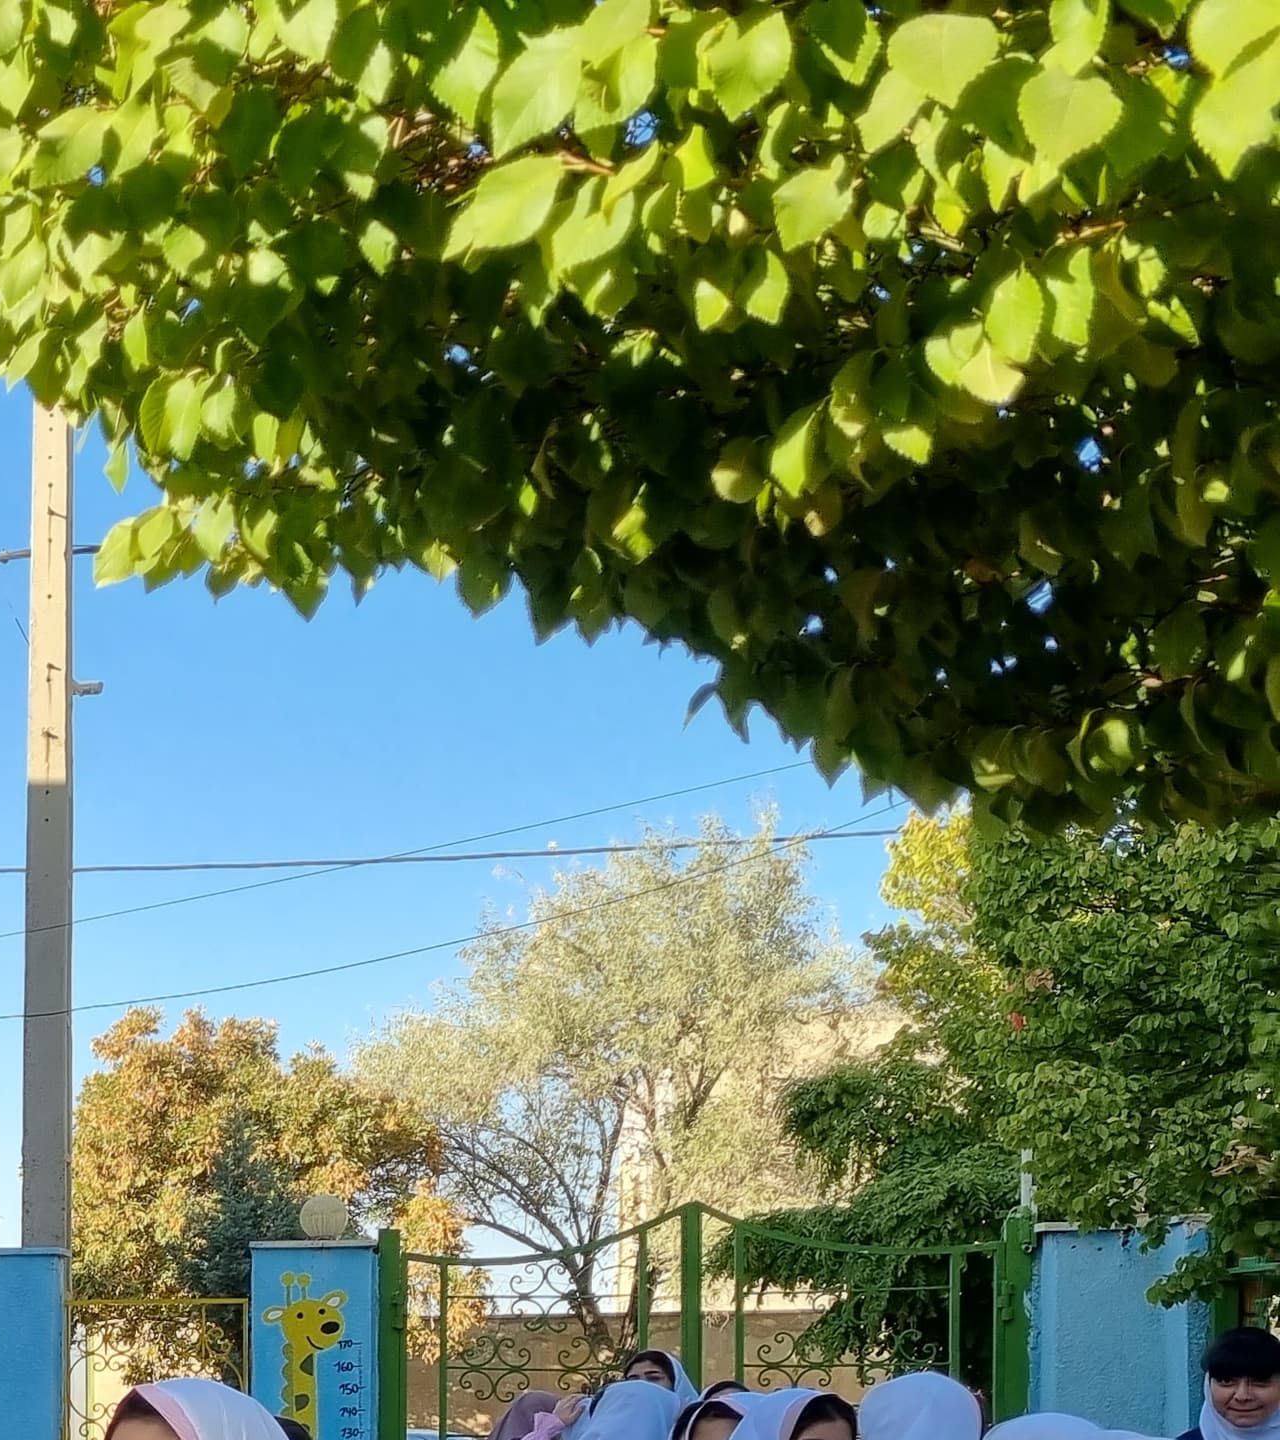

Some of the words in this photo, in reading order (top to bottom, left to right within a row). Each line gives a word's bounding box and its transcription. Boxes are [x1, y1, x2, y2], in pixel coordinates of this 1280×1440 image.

[334, 1362, 354, 1372] 160
[339, 1383, 359, 1395] 150
[339, 1406, 358, 1417] 140
[341, 1427, 360, 1439] 130
